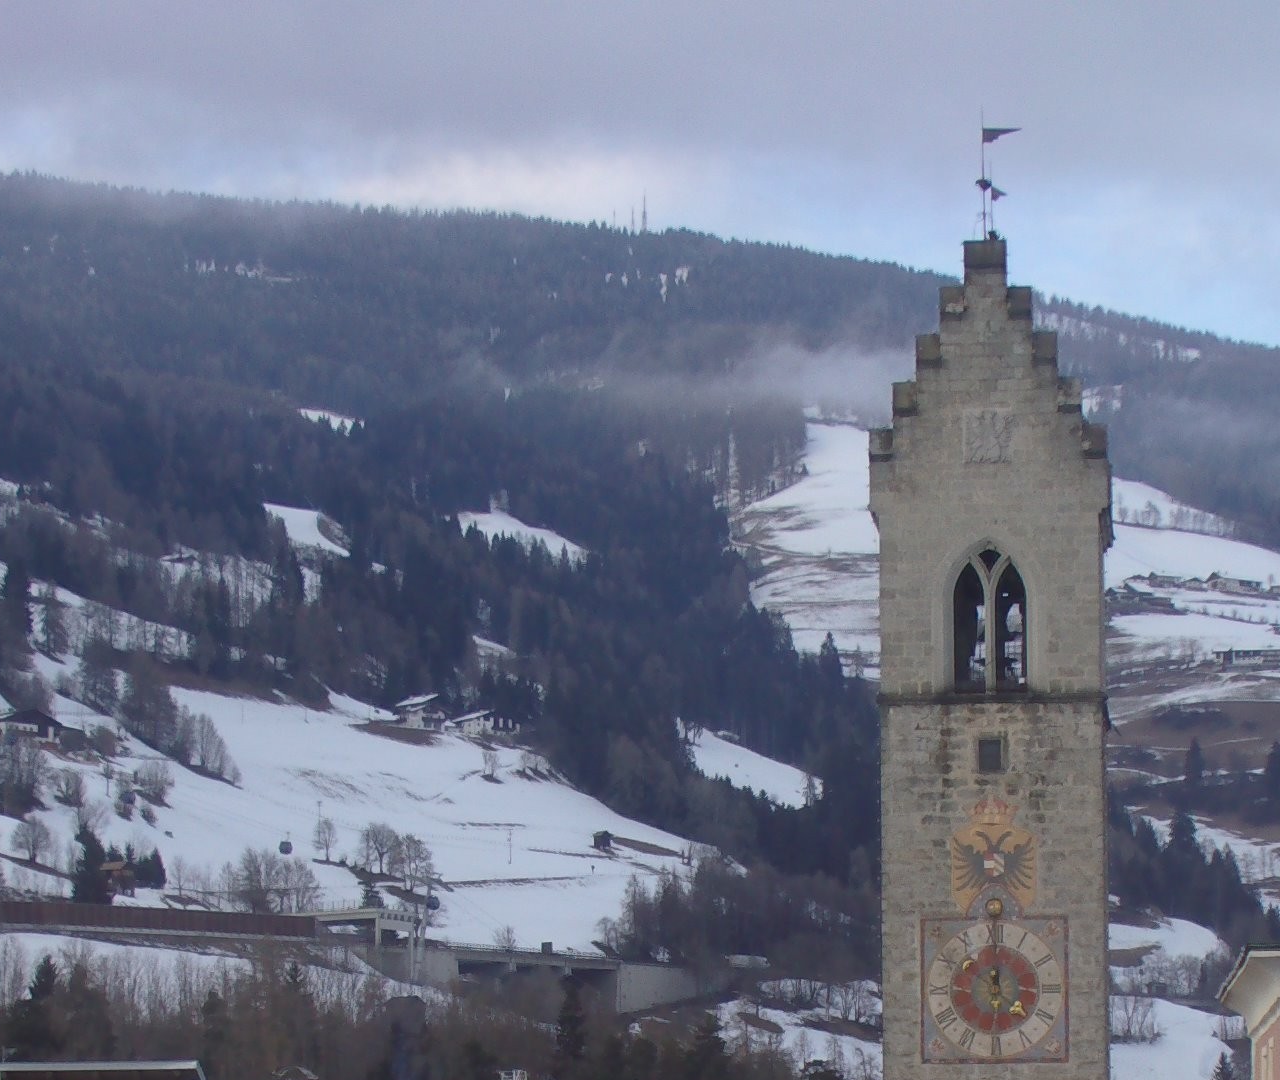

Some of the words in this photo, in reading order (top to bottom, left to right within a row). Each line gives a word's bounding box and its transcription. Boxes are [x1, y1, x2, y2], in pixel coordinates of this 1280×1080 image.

[1017, 931, 1028, 949] I
[1034, 953, 1054, 969] II
[929, 984, 949, 995] IX
[1041, 983, 1061, 994] III
[934, 1006, 958, 1029] VIII
[959, 1028, 976, 1050] VII
[1018, 1028, 1033, 1049] V
